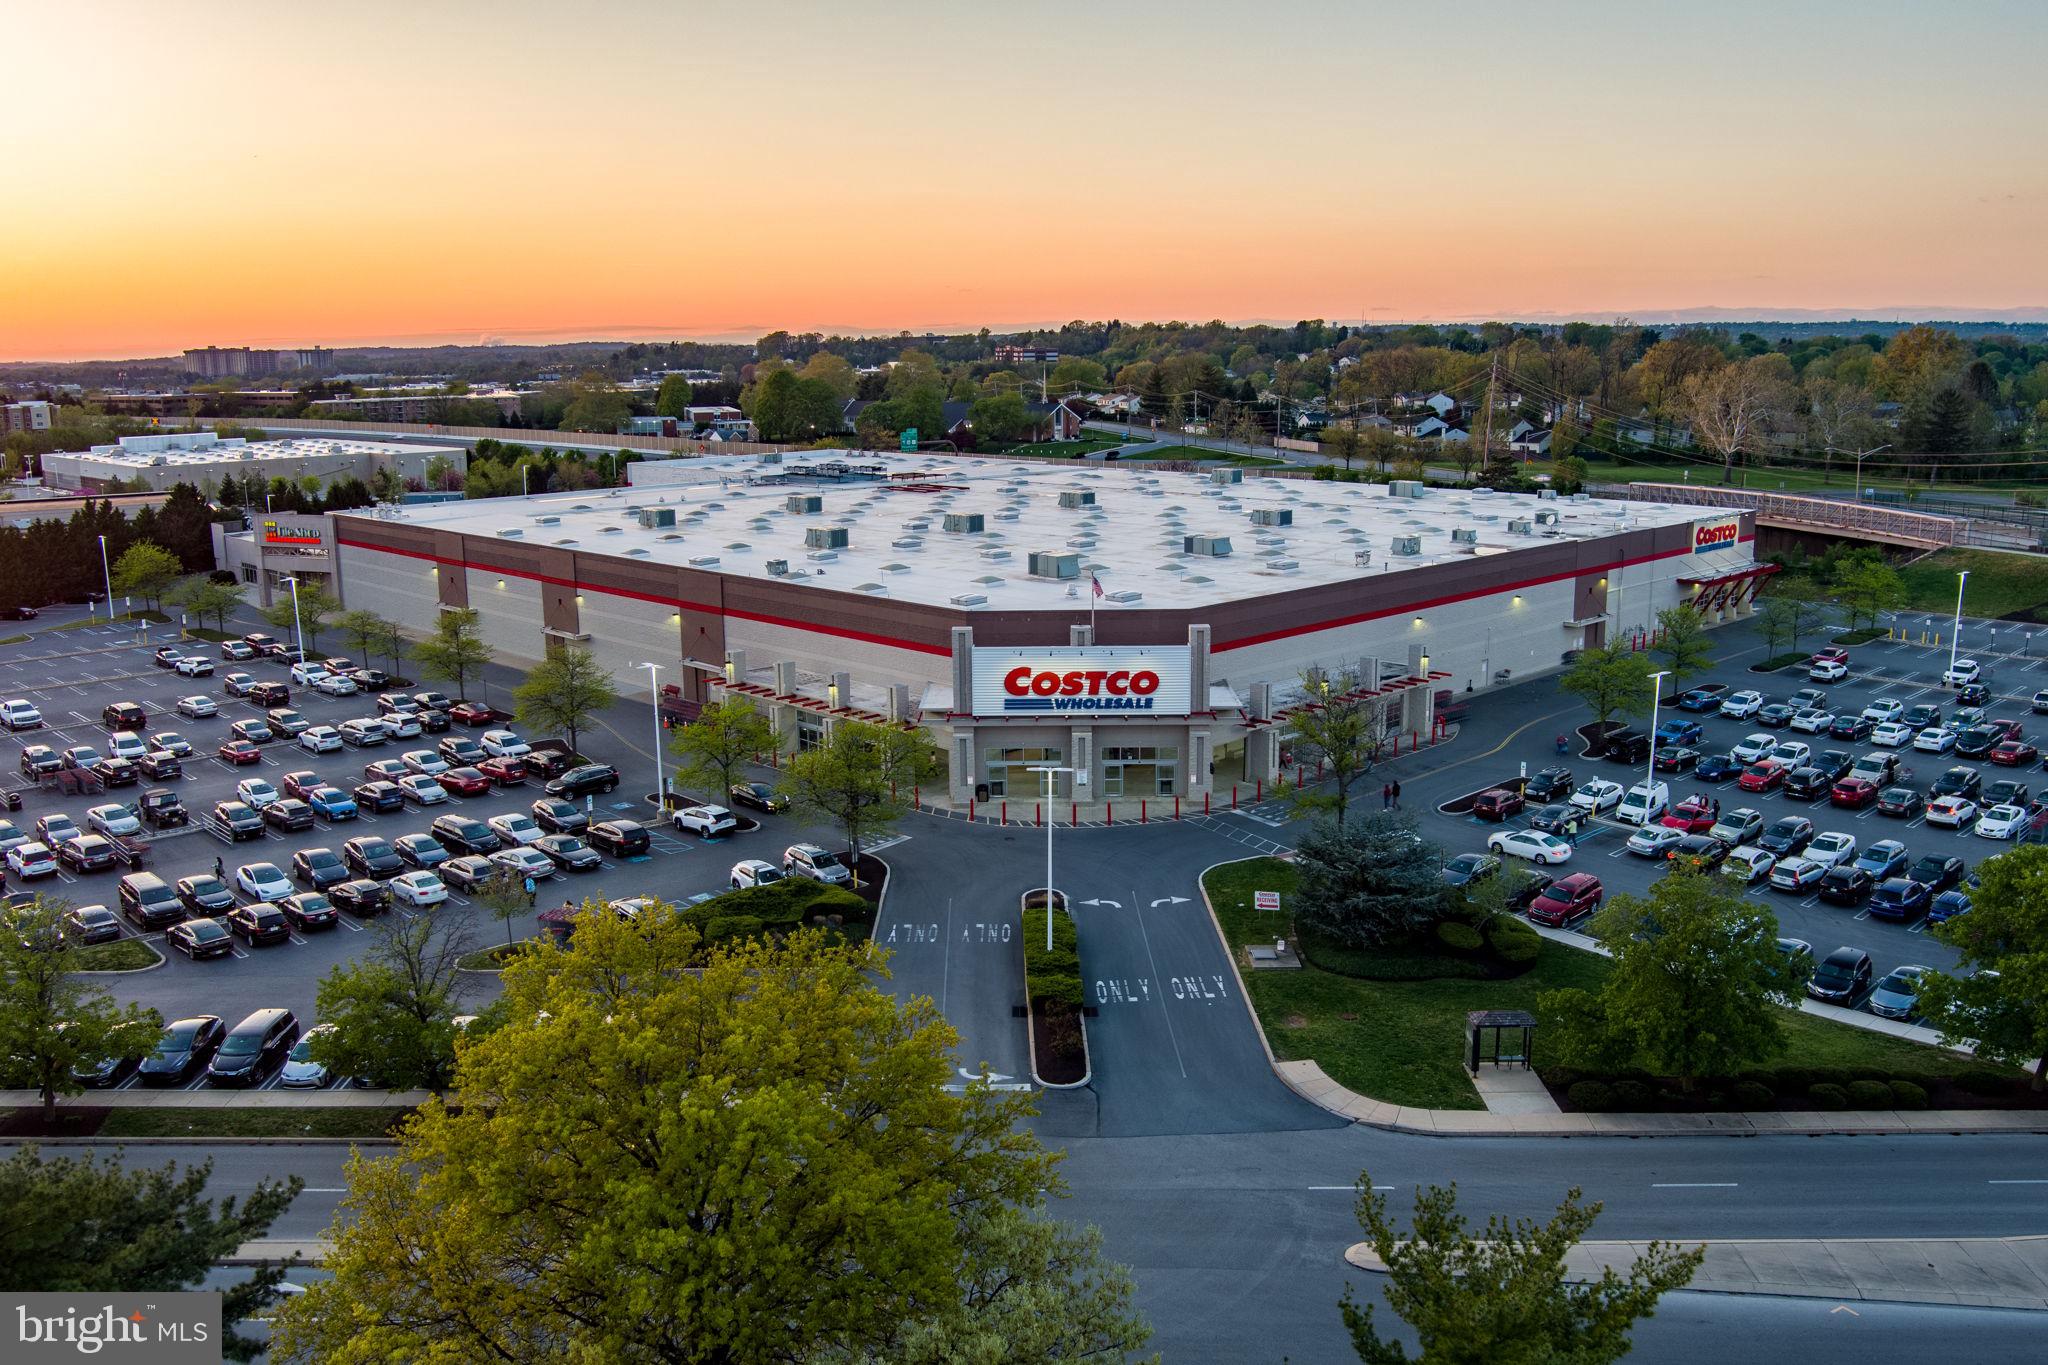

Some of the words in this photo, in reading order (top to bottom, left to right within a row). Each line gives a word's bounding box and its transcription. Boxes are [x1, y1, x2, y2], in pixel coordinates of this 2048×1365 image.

[1696, 524, 1737, 545] COSTCO
[1004, 667, 1160, 696] COSTCO
[1053, 697, 1154, 710] WHOLESALE
[887, 923, 938, 942] ONLY
[961, 923, 1011, 942] ONLY
[1096, 979, 1149, 1003] ONLY
[1171, 975, 1227, 999] ONLY
